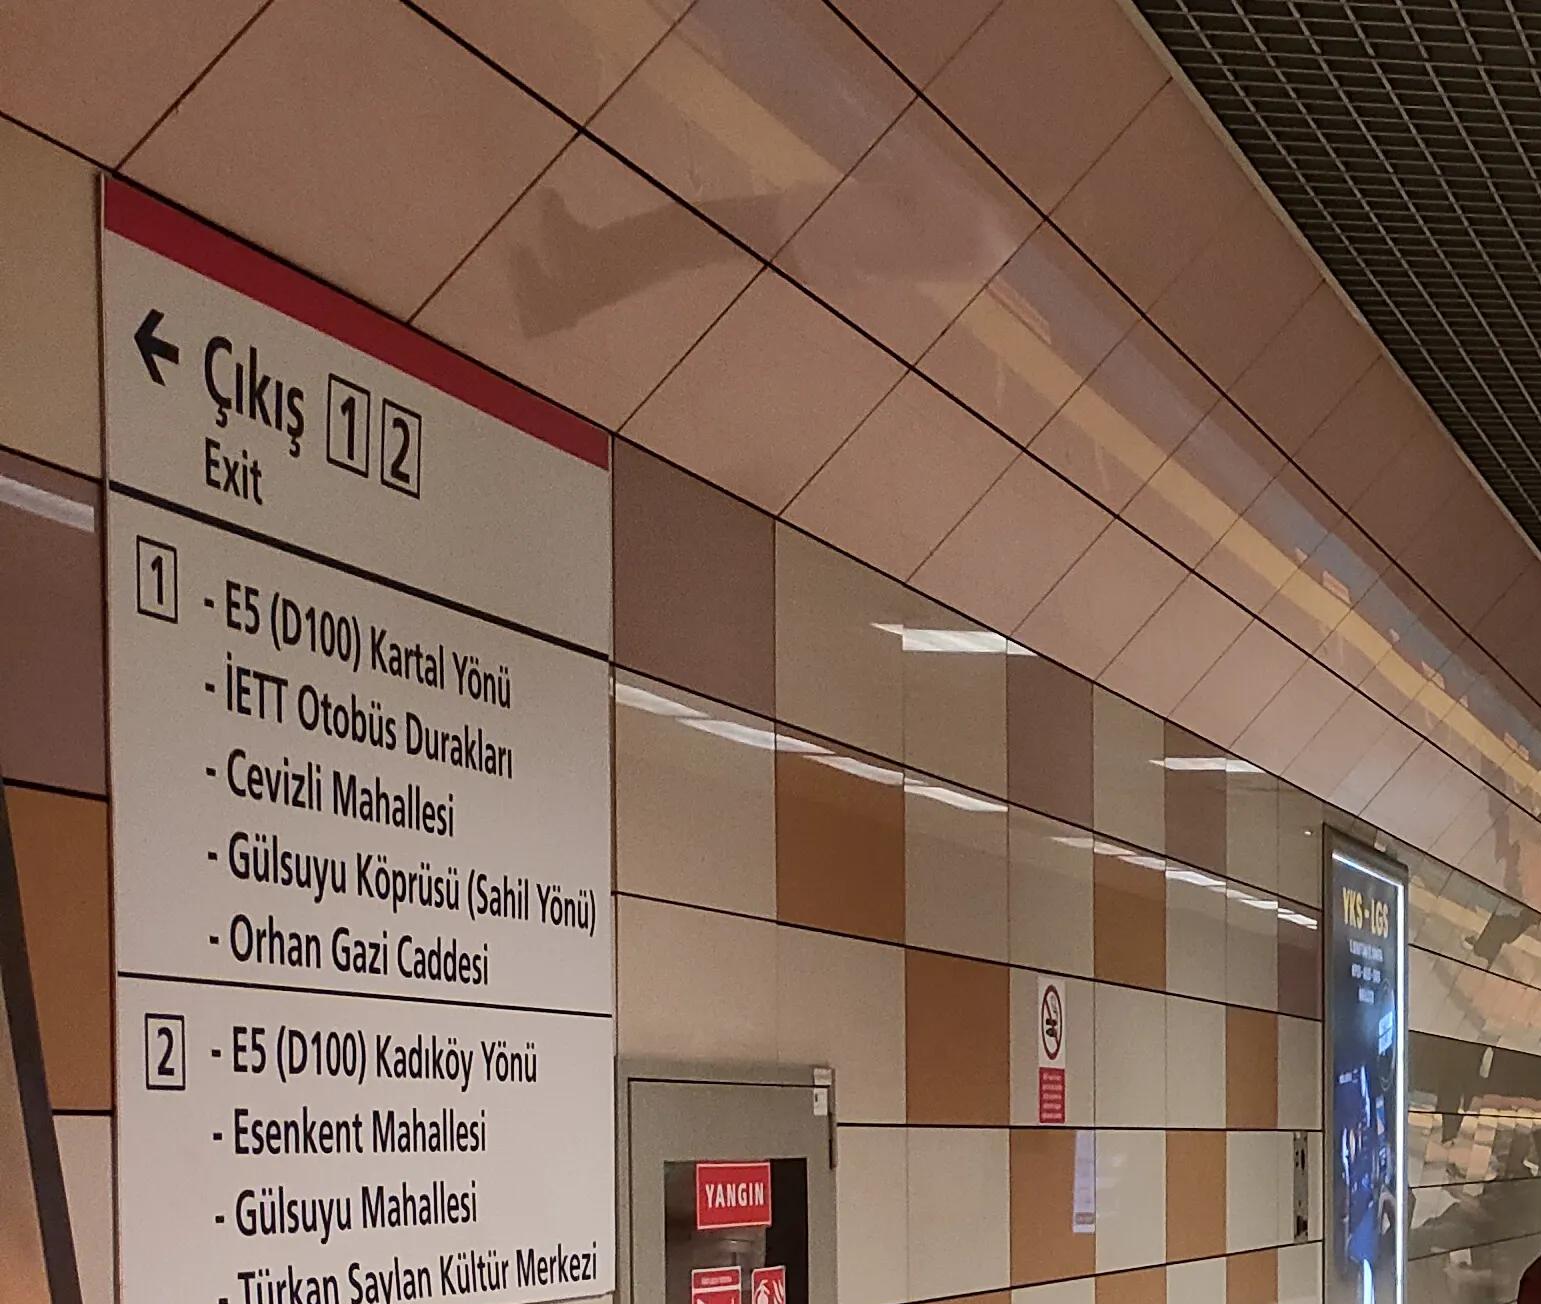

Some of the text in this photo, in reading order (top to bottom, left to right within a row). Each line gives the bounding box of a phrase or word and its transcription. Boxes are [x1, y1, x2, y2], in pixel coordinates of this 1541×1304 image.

[204, 335, 411, 485] Çıkış 1 2
[204, 436, 263, 506] Exit
[150, 555, 164, 606] 1
[225, 579, 261, 635] E5
[270, 597, 362, 673] (D100)
[370, 625, 445, 690] Kartal
[451, 651, 511, 709] Yönü
[226, 651, 289, 724] İETT
[297, 684, 397, 751] Otobüs
[404, 717, 514, 780] Durakları
[227, 748, 322, 812] Cevizli
[332, 770, 454, 838] Mahallesi
[228, 831, 347, 904] Gülsuyu
[356, 852, 460, 914] Köprüsü
[467, 868, 529, 921] (Sahil
[535, 883, 596, 938] Yönü)
[229, 913, 322, 969] Orhan
[331, 926, 388, 976] Gazi
[397, 934, 488, 986] Caddesi
[157, 1026, 175, 1077] 2
[232, 1025, 267, 1074] E5
[276, 1025, 367, 1086] (D100)
[376, 1034, 474, 1093] Kadıköy
[480, 1040, 537, 1083] Yönü
[234, 1105, 364, 1155] Esenkent
[372, 1107, 486, 1153] Mahallesi
[235, 1185, 352, 1245] Gülsuyu
[361, 1179, 477, 1229] Mahallesi
[439, 1249, 509, 1296] Kültür
[515, 1241, 597, 1288] Merkezi
